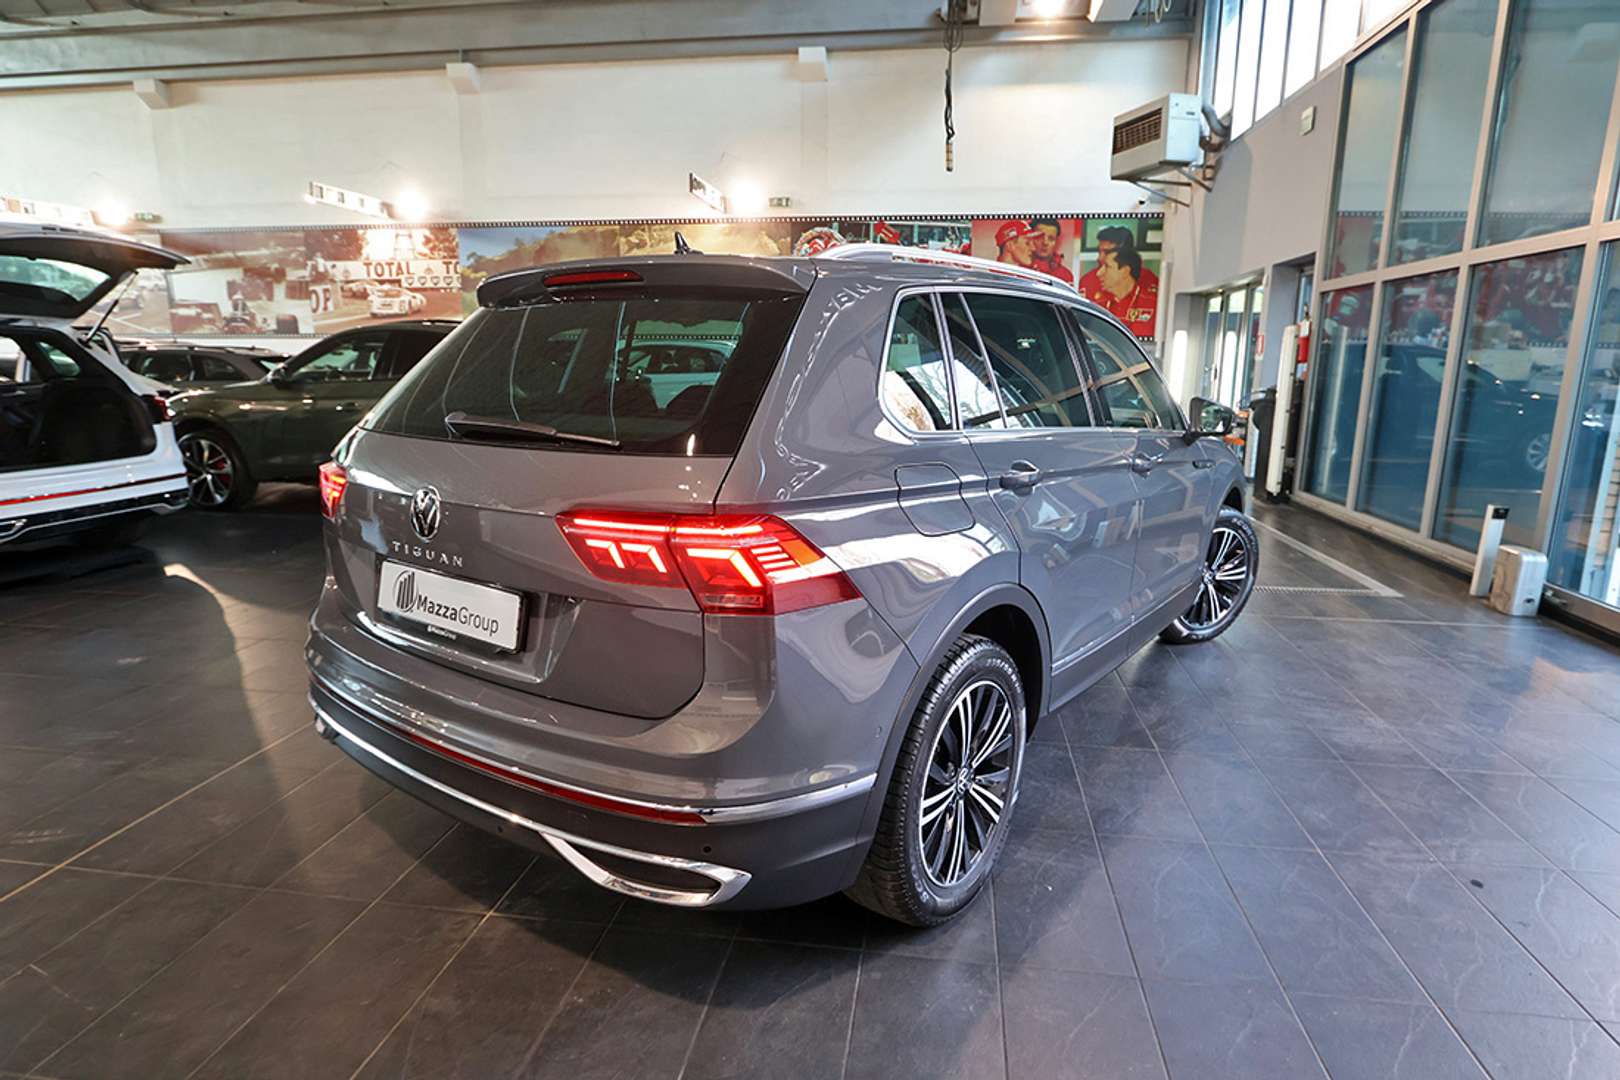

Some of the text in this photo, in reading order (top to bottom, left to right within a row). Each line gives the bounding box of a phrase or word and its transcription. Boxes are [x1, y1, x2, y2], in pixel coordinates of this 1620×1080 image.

[363, 261, 416, 278] TOTAL
[392, 540, 464, 568] TIGUAN
[416, 593, 500, 636] MazzaGroup
